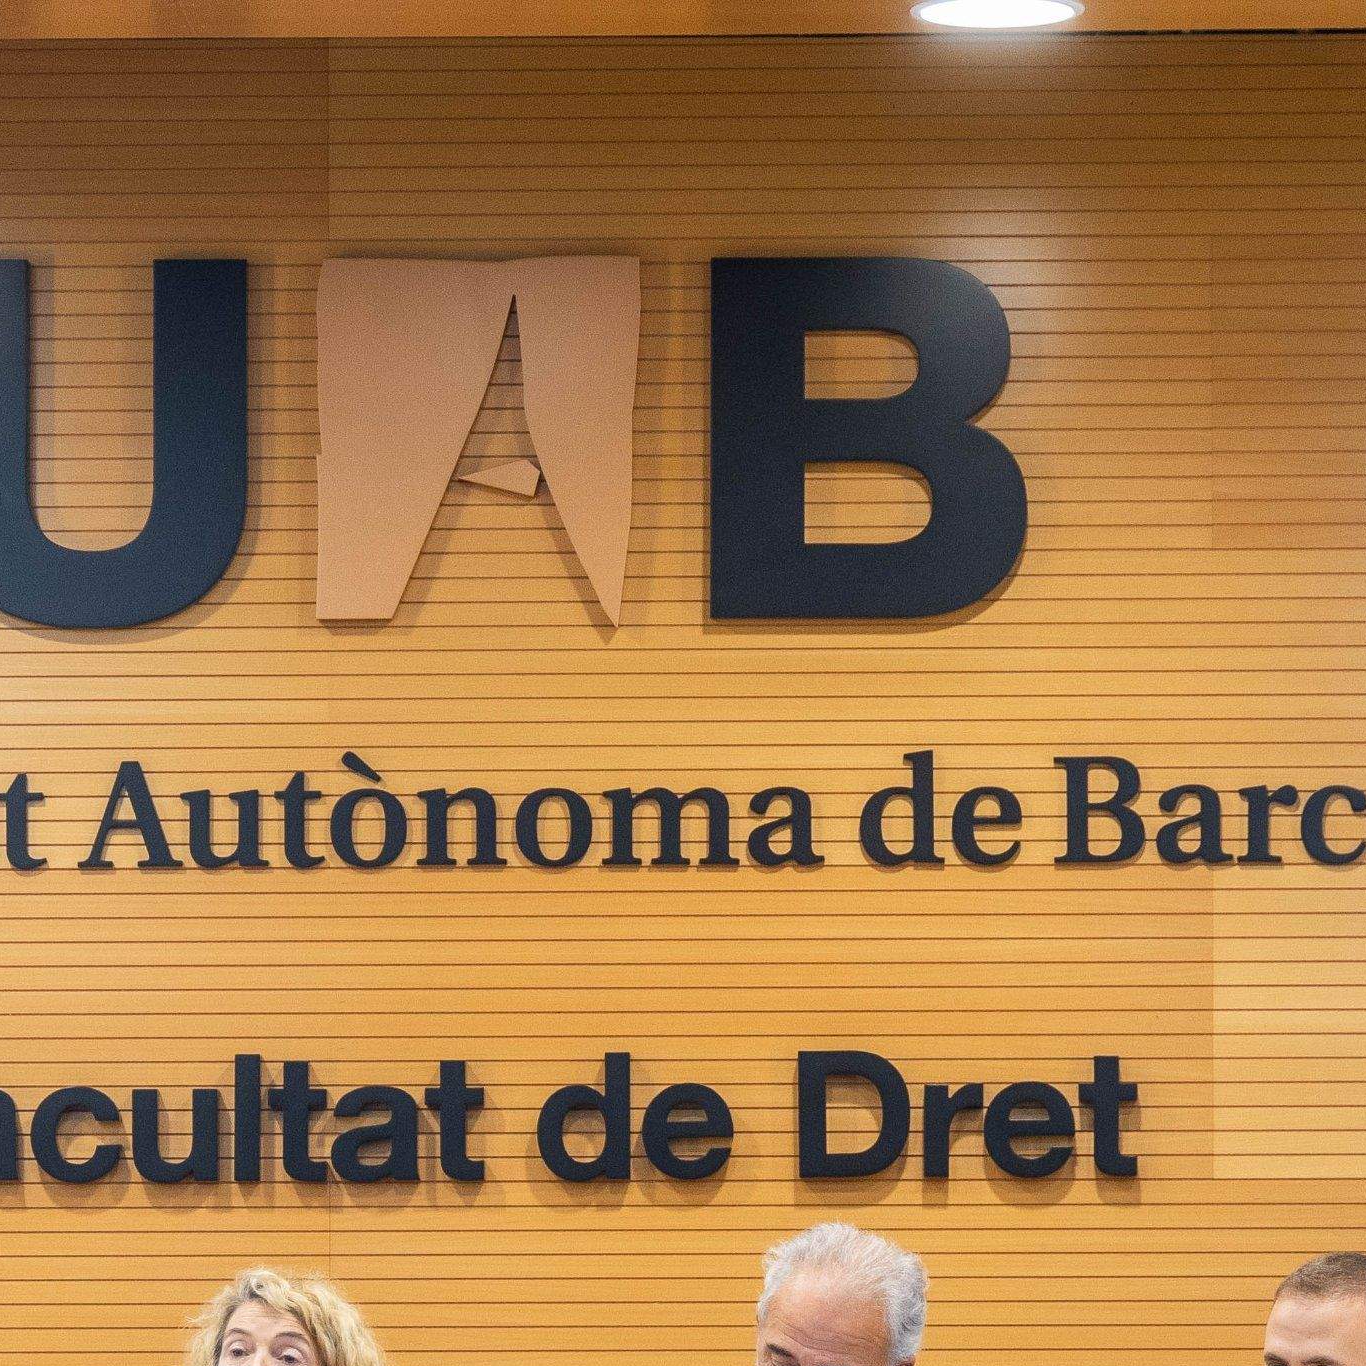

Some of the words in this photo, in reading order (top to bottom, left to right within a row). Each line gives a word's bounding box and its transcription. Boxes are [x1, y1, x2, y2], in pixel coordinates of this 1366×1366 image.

[78, 750, 825, 870] Autònoma
[858, 749, 1024, 868] de
[537, 1051, 734, 1184] de
[798, 1049, 1139, 1181] Dret
